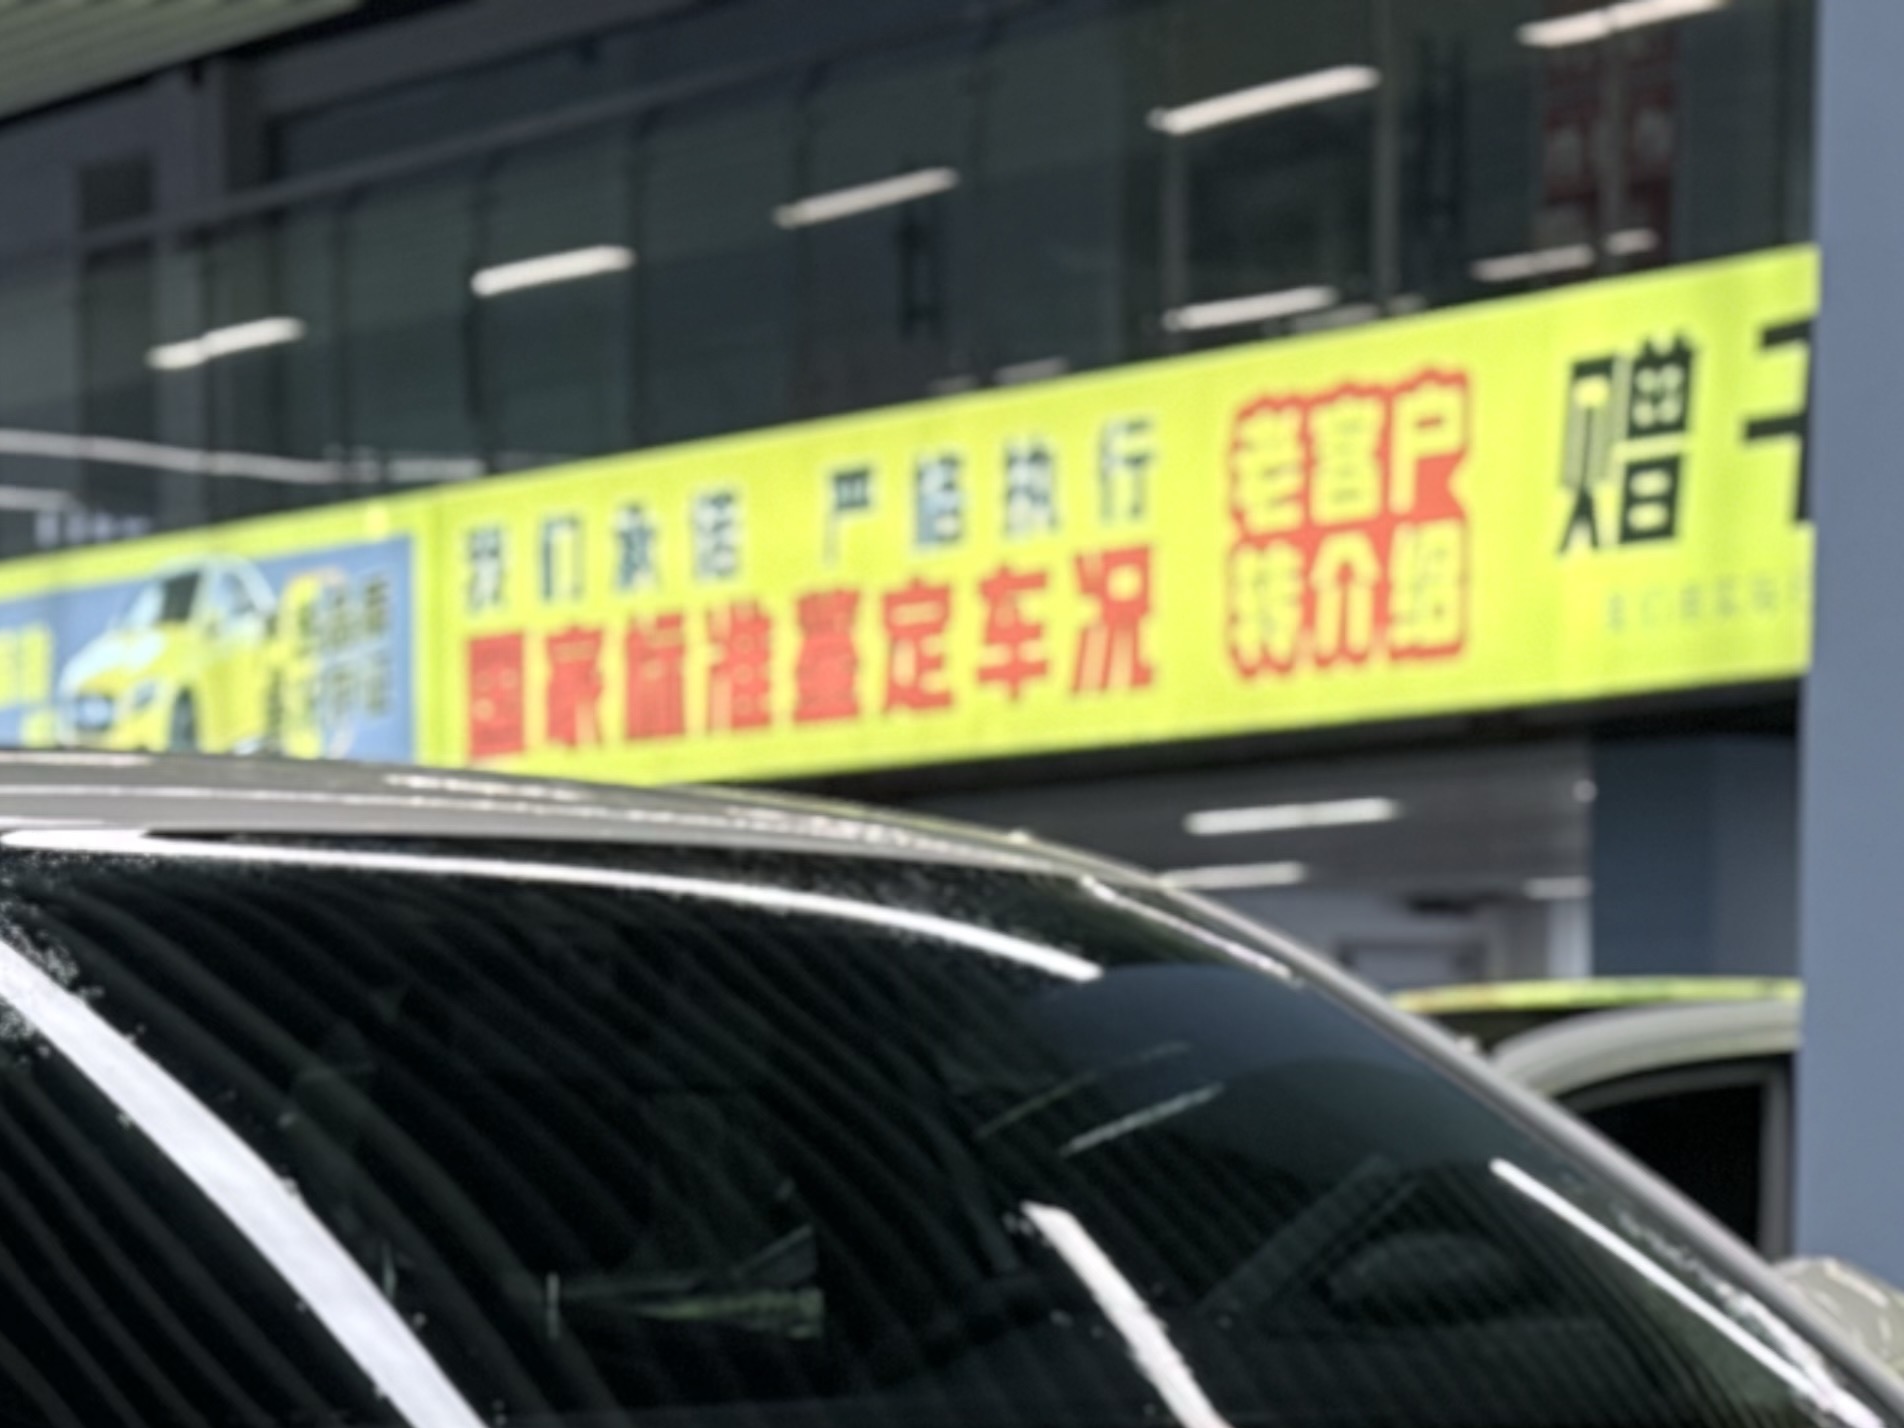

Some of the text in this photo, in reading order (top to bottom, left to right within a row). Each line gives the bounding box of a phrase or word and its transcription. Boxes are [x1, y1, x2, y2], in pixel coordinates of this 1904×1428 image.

[824, 420, 1152, 566] 严格执行
[1233, 374, 1467, 535] 老客户
